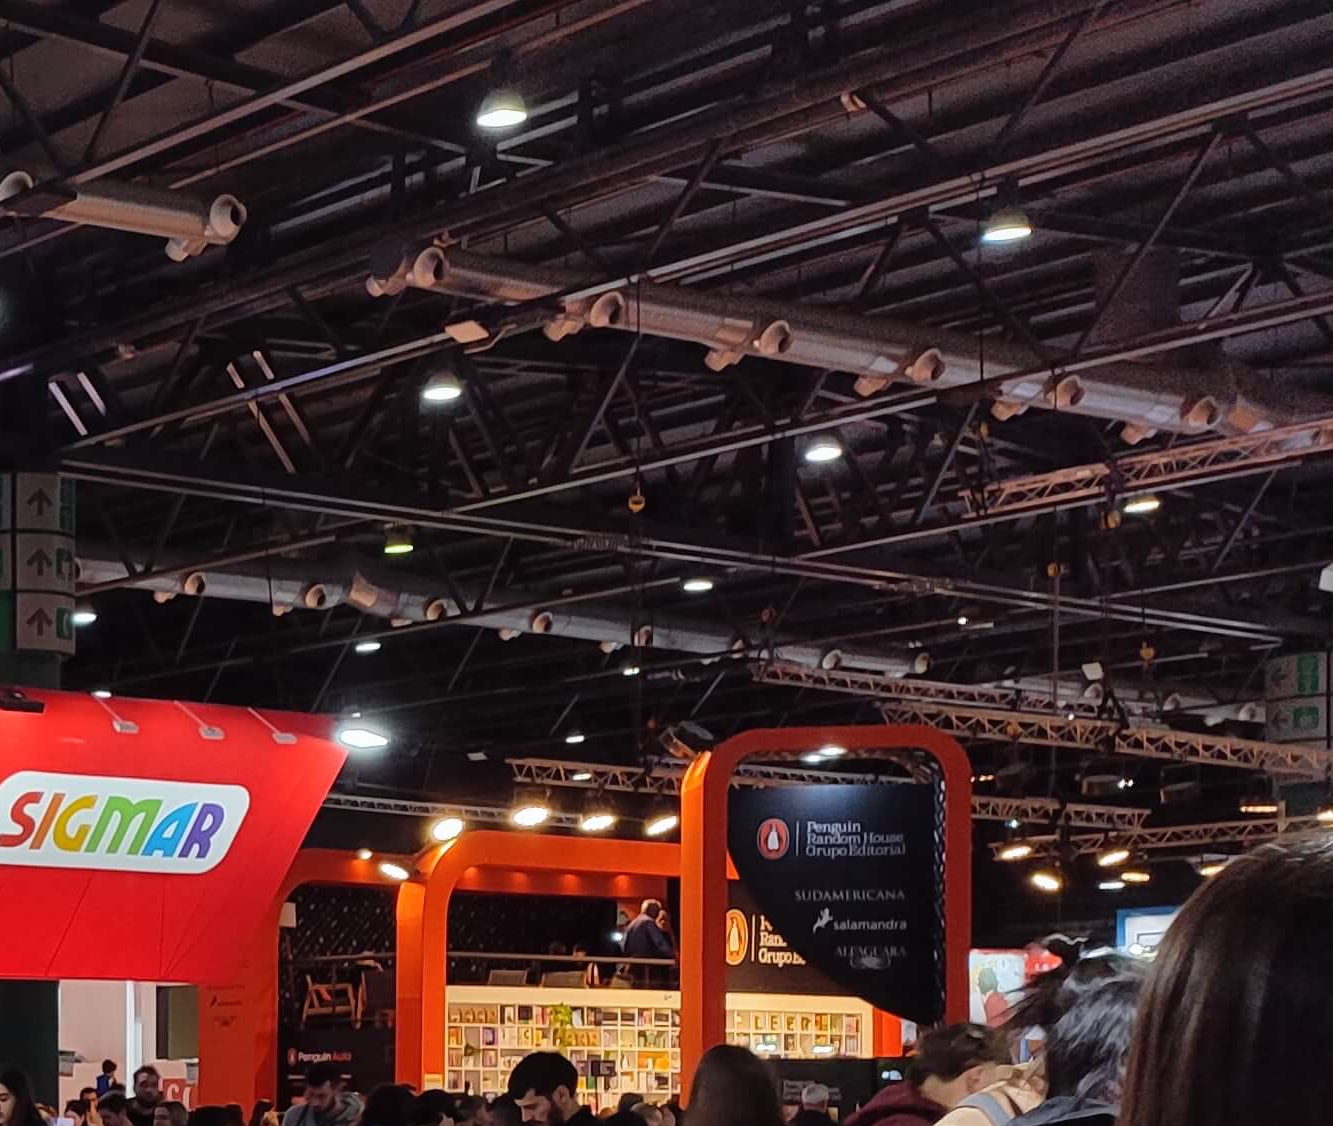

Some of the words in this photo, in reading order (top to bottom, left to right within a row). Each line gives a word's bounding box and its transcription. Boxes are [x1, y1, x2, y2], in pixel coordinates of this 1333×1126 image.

[806, 821, 861, 834] Penguin
[806, 833, 861, 845] Random
[863, 832, 904, 844] House
[805, 845, 848, 860] Grupo
[848, 843, 907, 857] Editorial
[795, 890, 905, 901] SUDAMERICANA
[833, 918, 907, 931] salamandra
